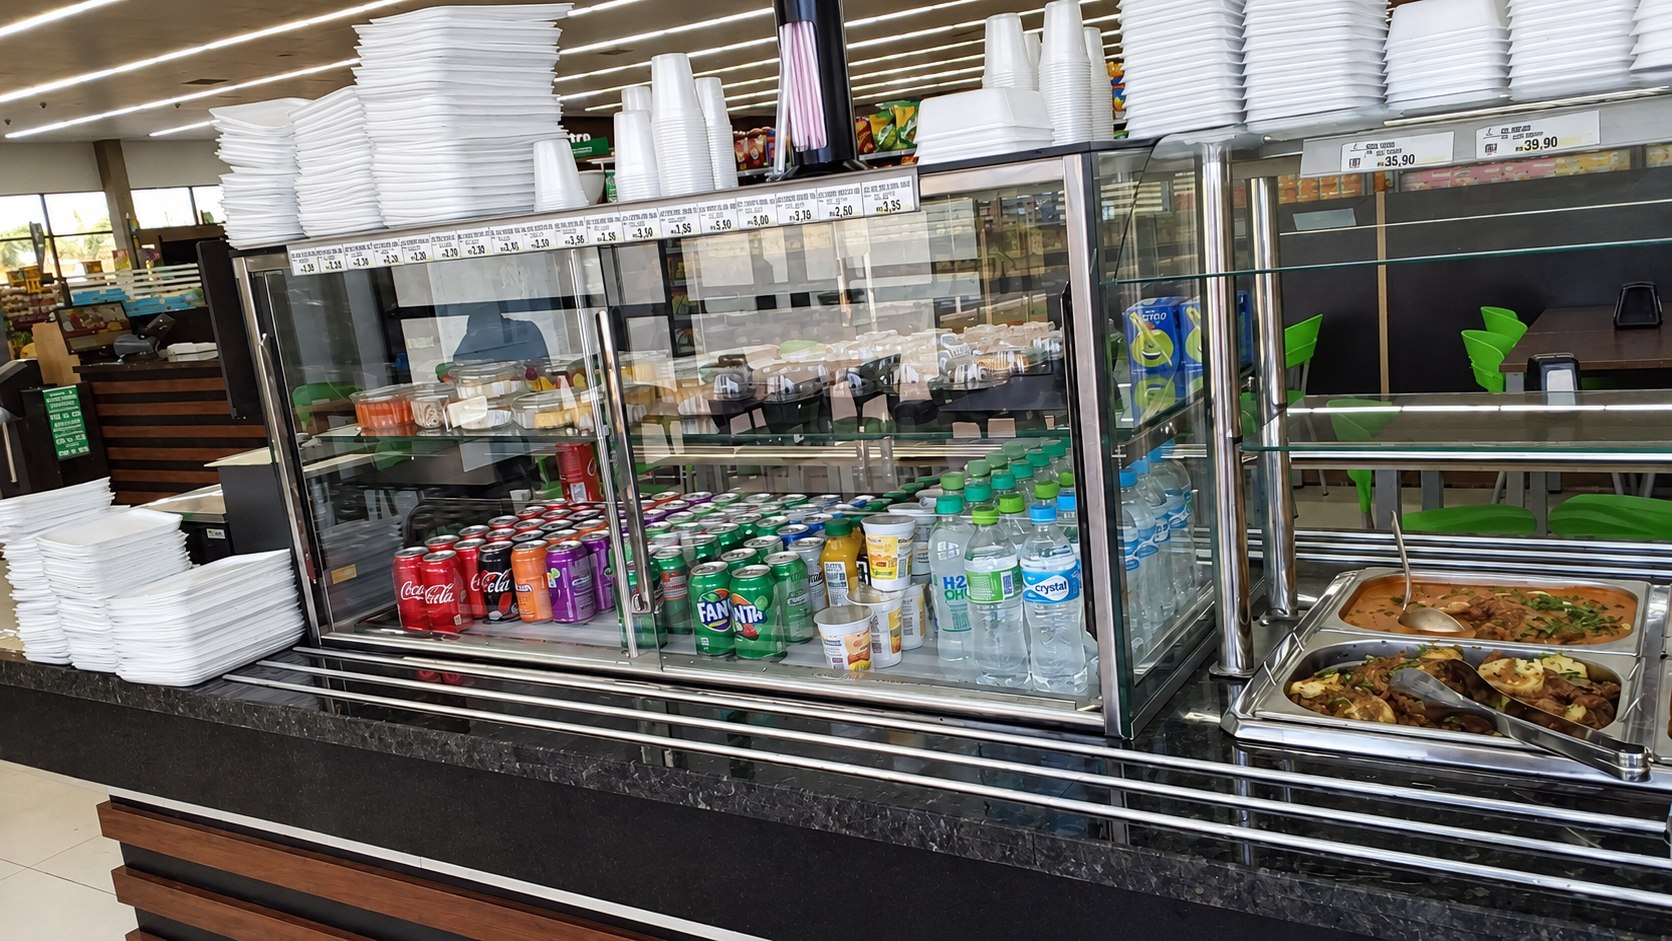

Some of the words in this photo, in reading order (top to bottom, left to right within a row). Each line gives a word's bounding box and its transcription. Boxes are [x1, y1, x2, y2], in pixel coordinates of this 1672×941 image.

[1384, 153, 1416, 167] 35,90
[1034, 580, 1068, 595] crystal
[696, 599, 732, 623] FAN
[733, 604, 763, 624] NTA
